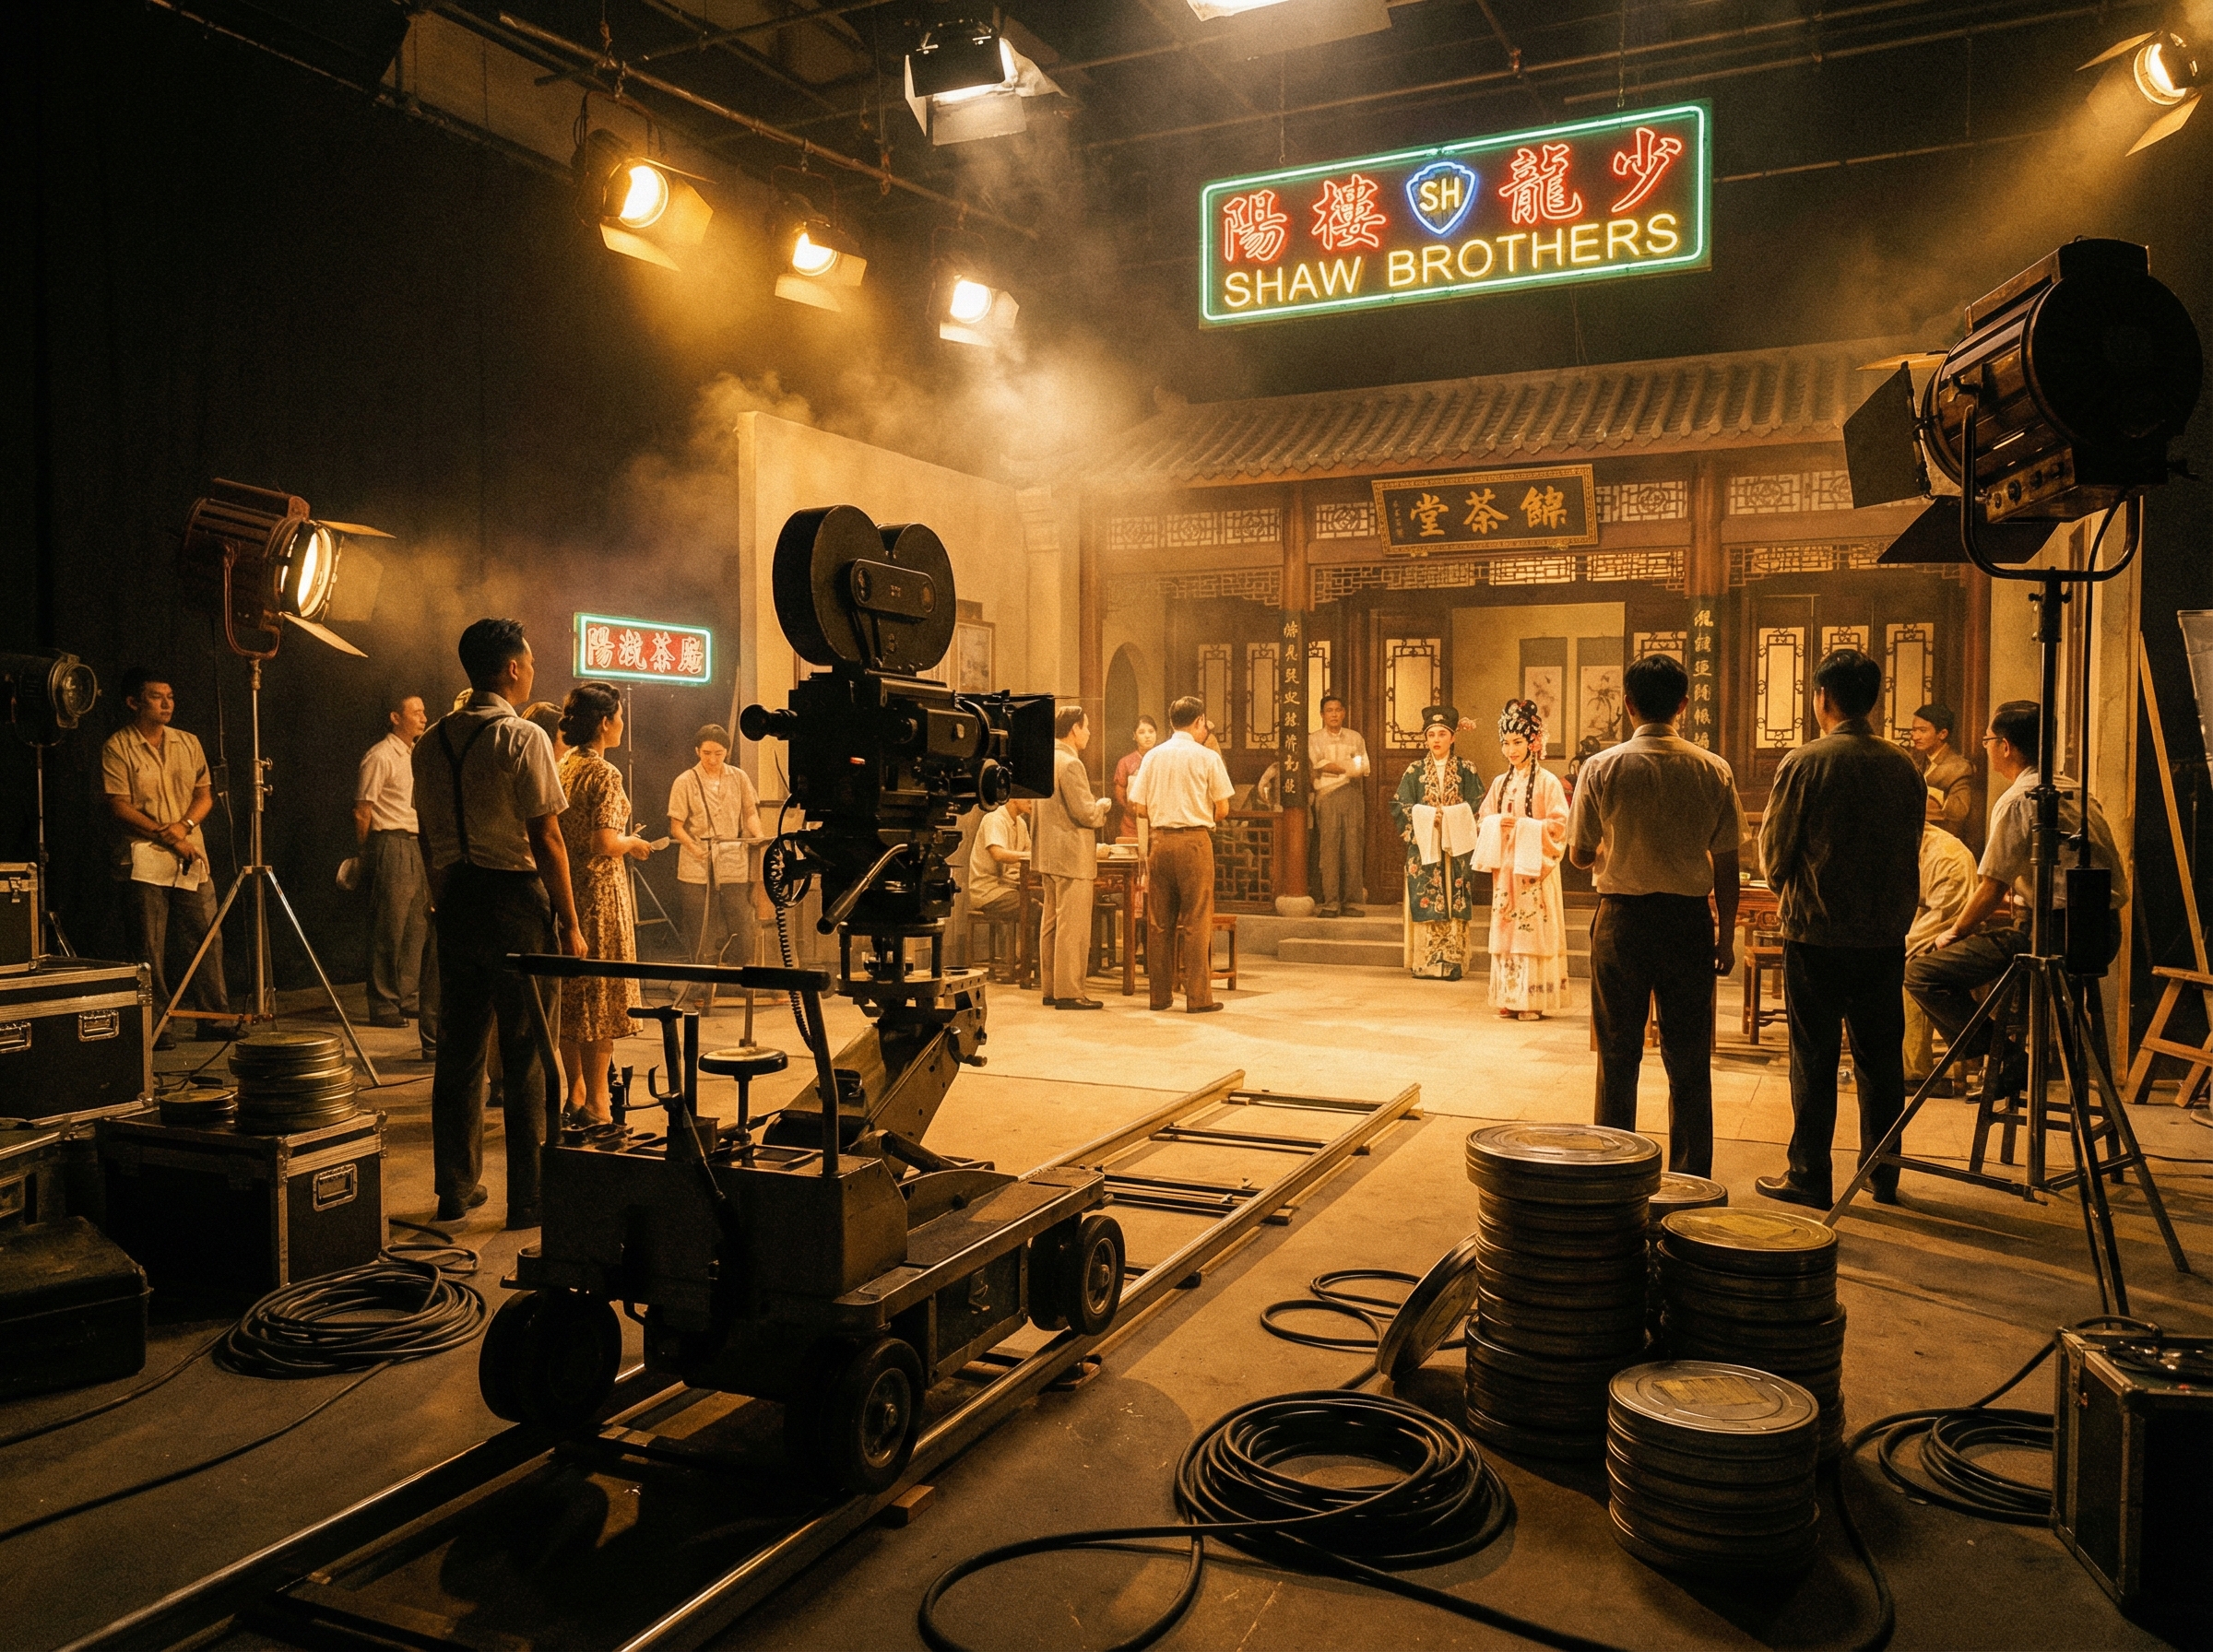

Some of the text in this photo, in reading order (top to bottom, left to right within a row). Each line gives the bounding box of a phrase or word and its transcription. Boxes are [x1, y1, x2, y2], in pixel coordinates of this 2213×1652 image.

[1419, 176, 1460, 212] SH
[1224, 213, 1678, 307] SHAW BROTHERS
